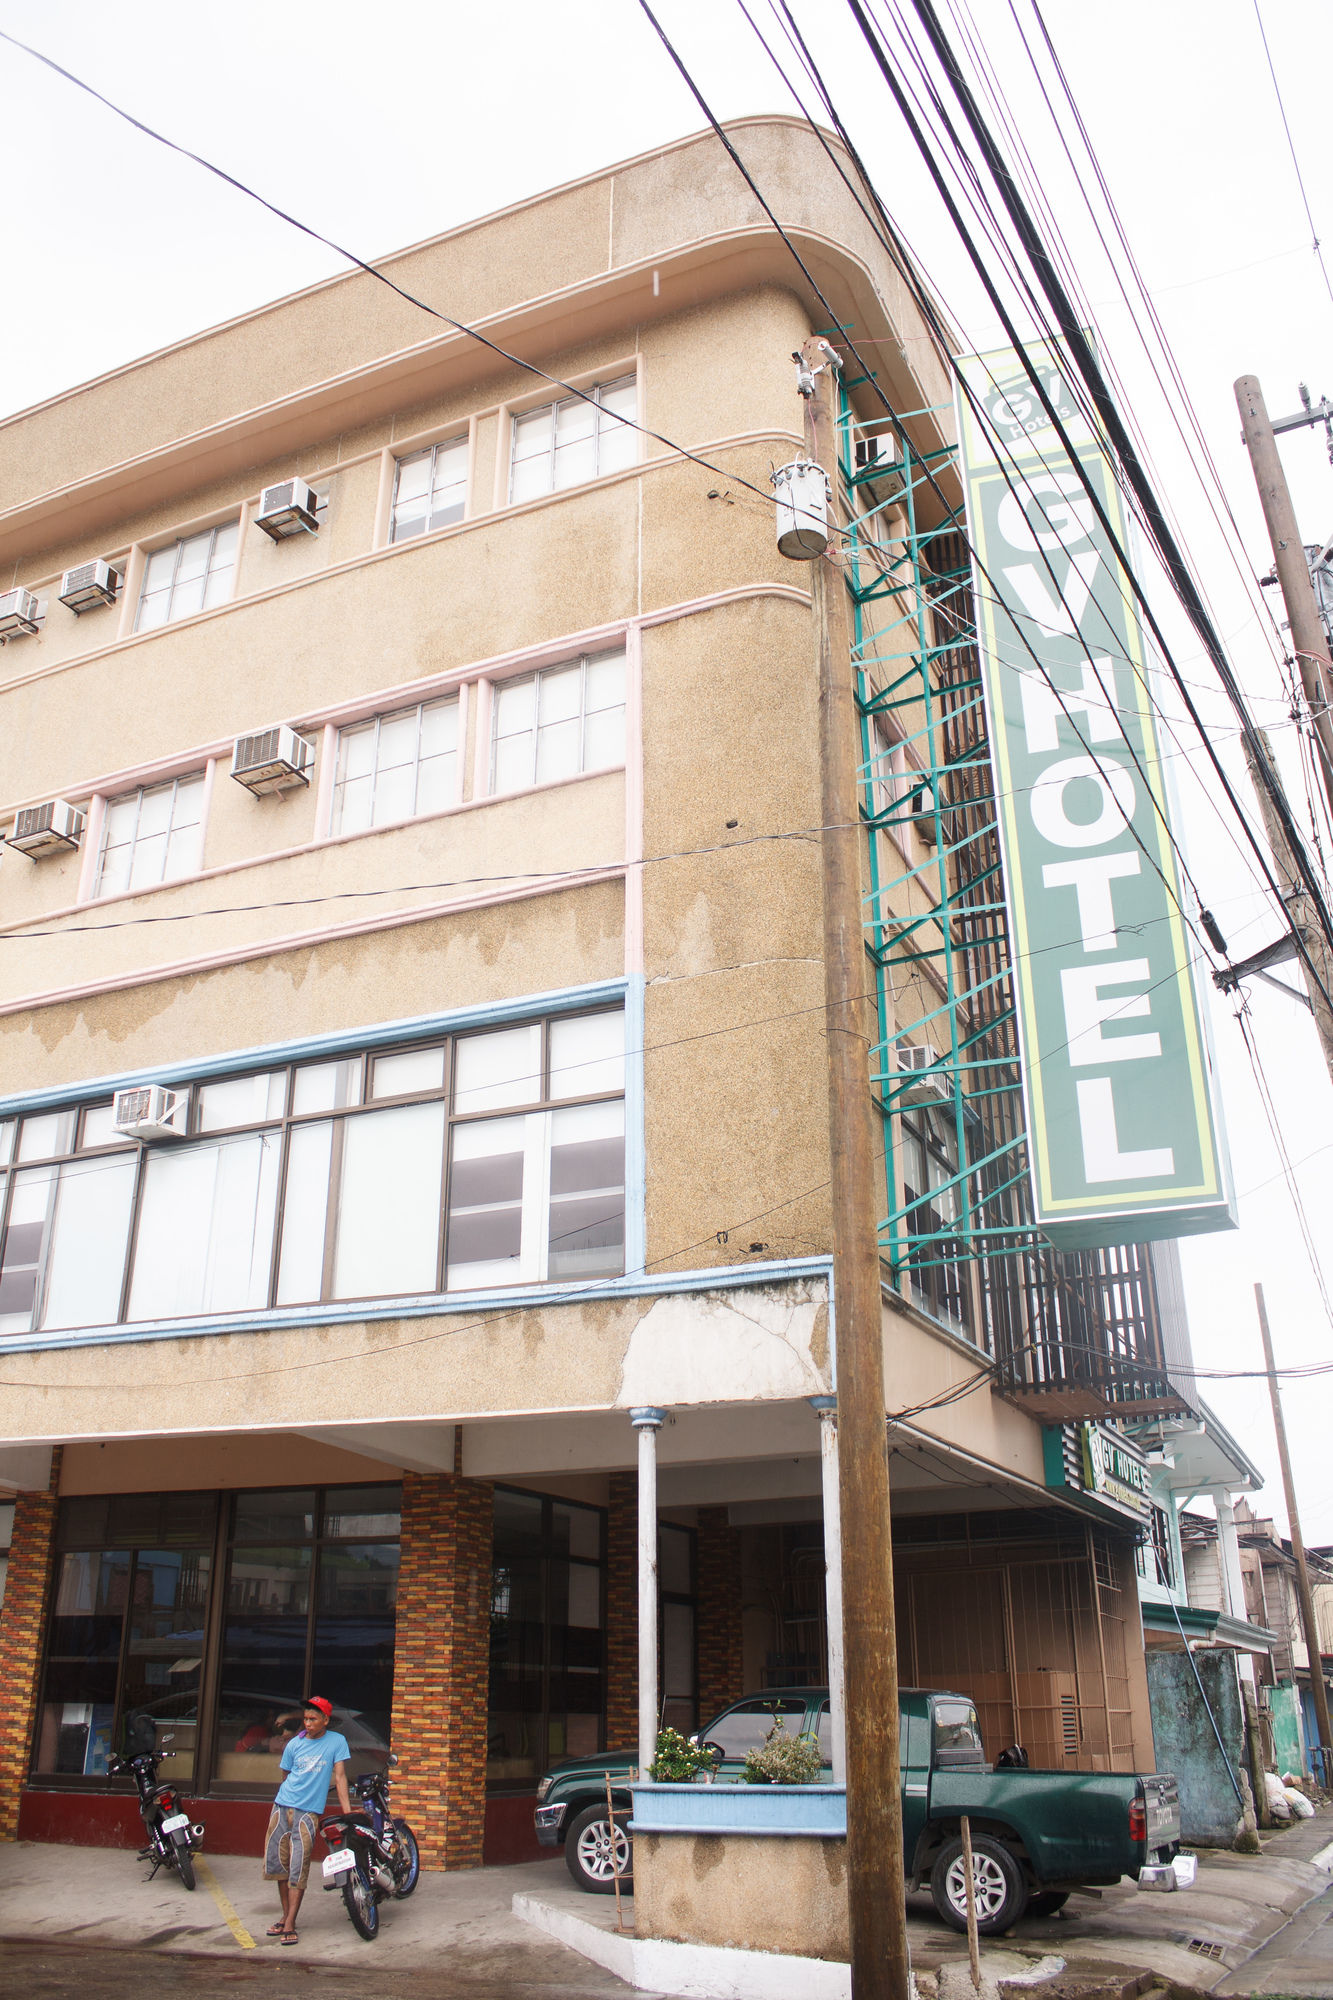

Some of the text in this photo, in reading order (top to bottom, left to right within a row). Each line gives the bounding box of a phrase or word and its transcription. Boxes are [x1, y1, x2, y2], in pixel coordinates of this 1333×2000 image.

[992, 374, 1061, 425] GV
[998, 472, 1175, 1184] GV HOTEL
[1103, 1439, 1146, 1491] GV HOTELS
